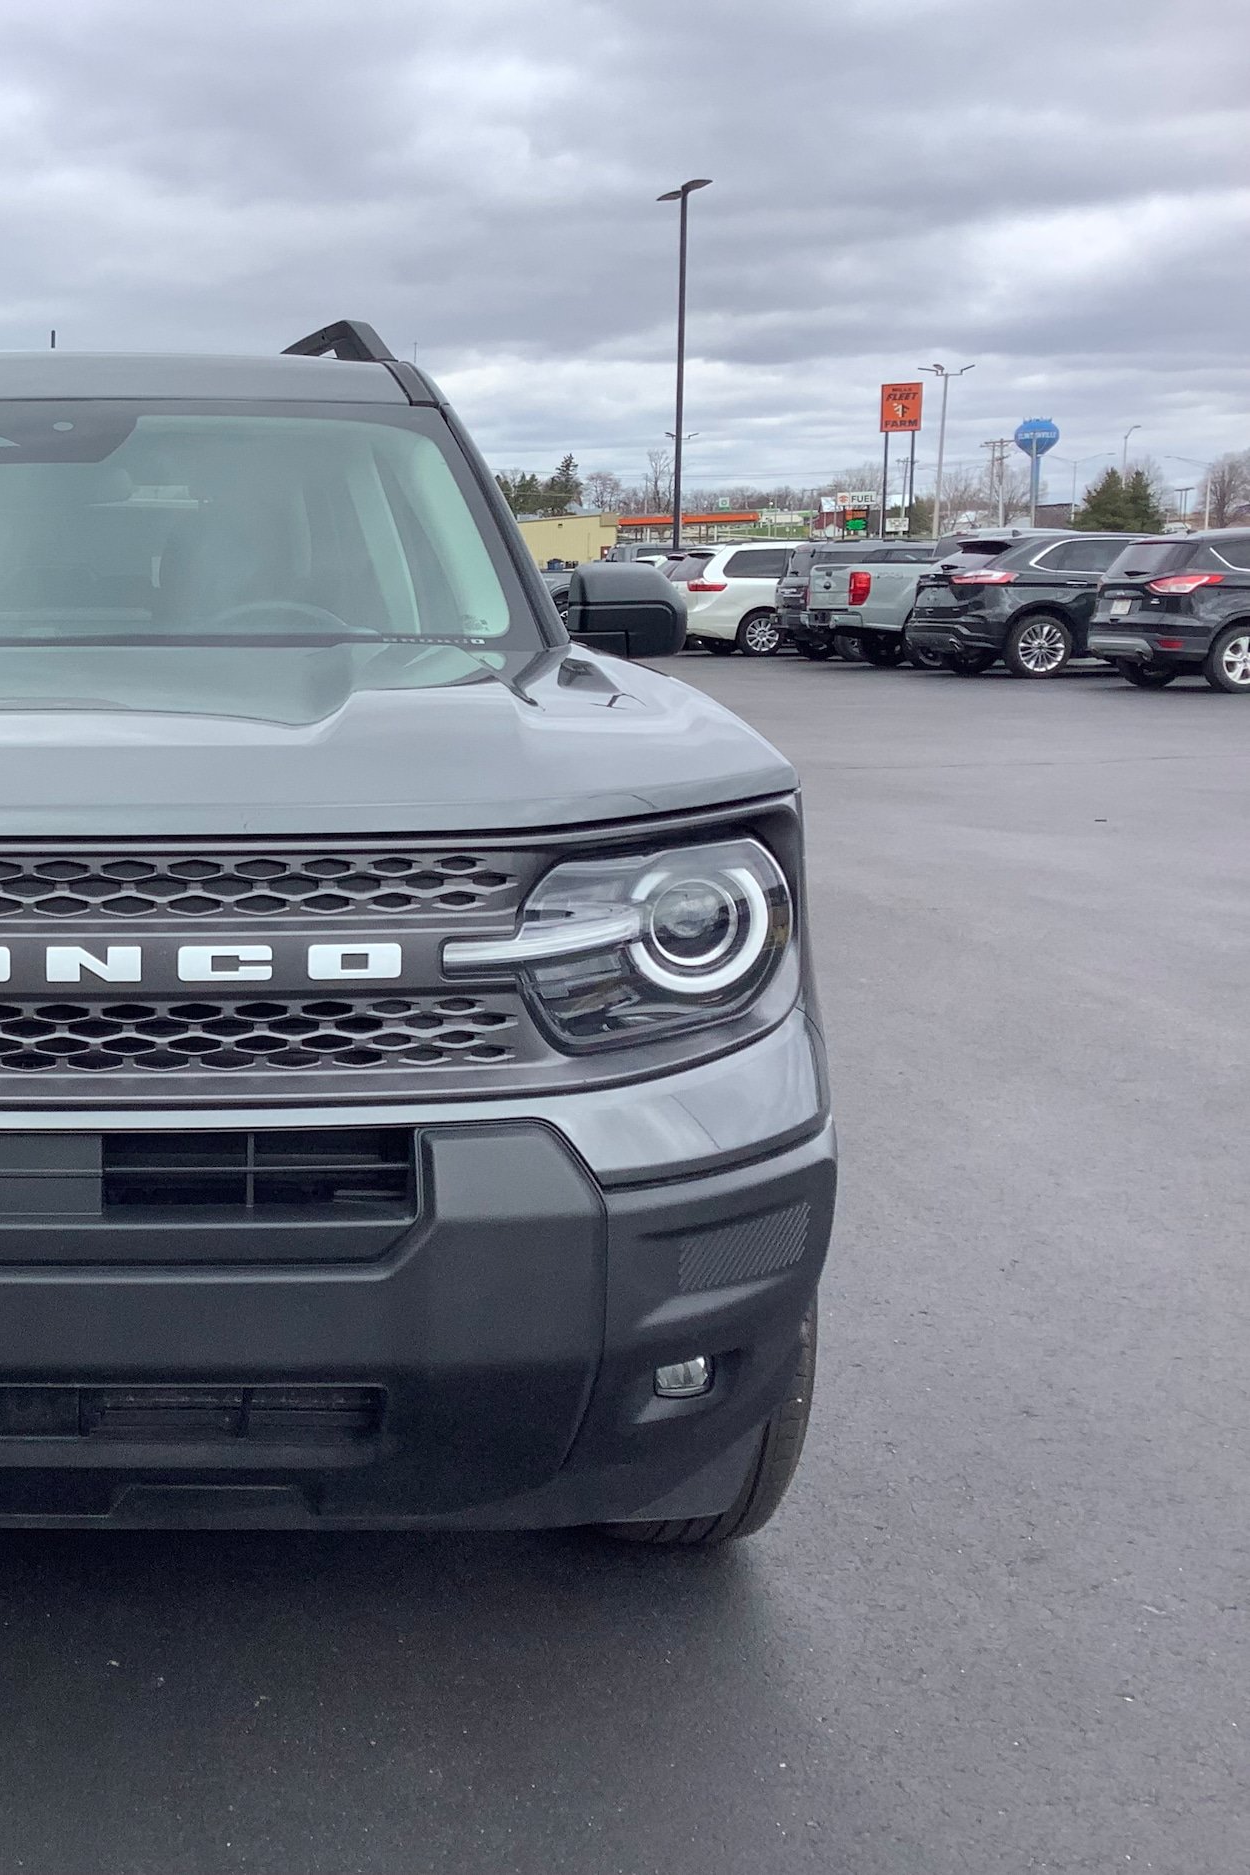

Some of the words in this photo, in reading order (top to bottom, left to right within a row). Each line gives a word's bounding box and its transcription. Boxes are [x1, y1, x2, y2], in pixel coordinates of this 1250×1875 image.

[886, 392, 919, 401] FLEET
[884, 420, 918, 428] FARM
[851, 495, 875, 503] FUEL
